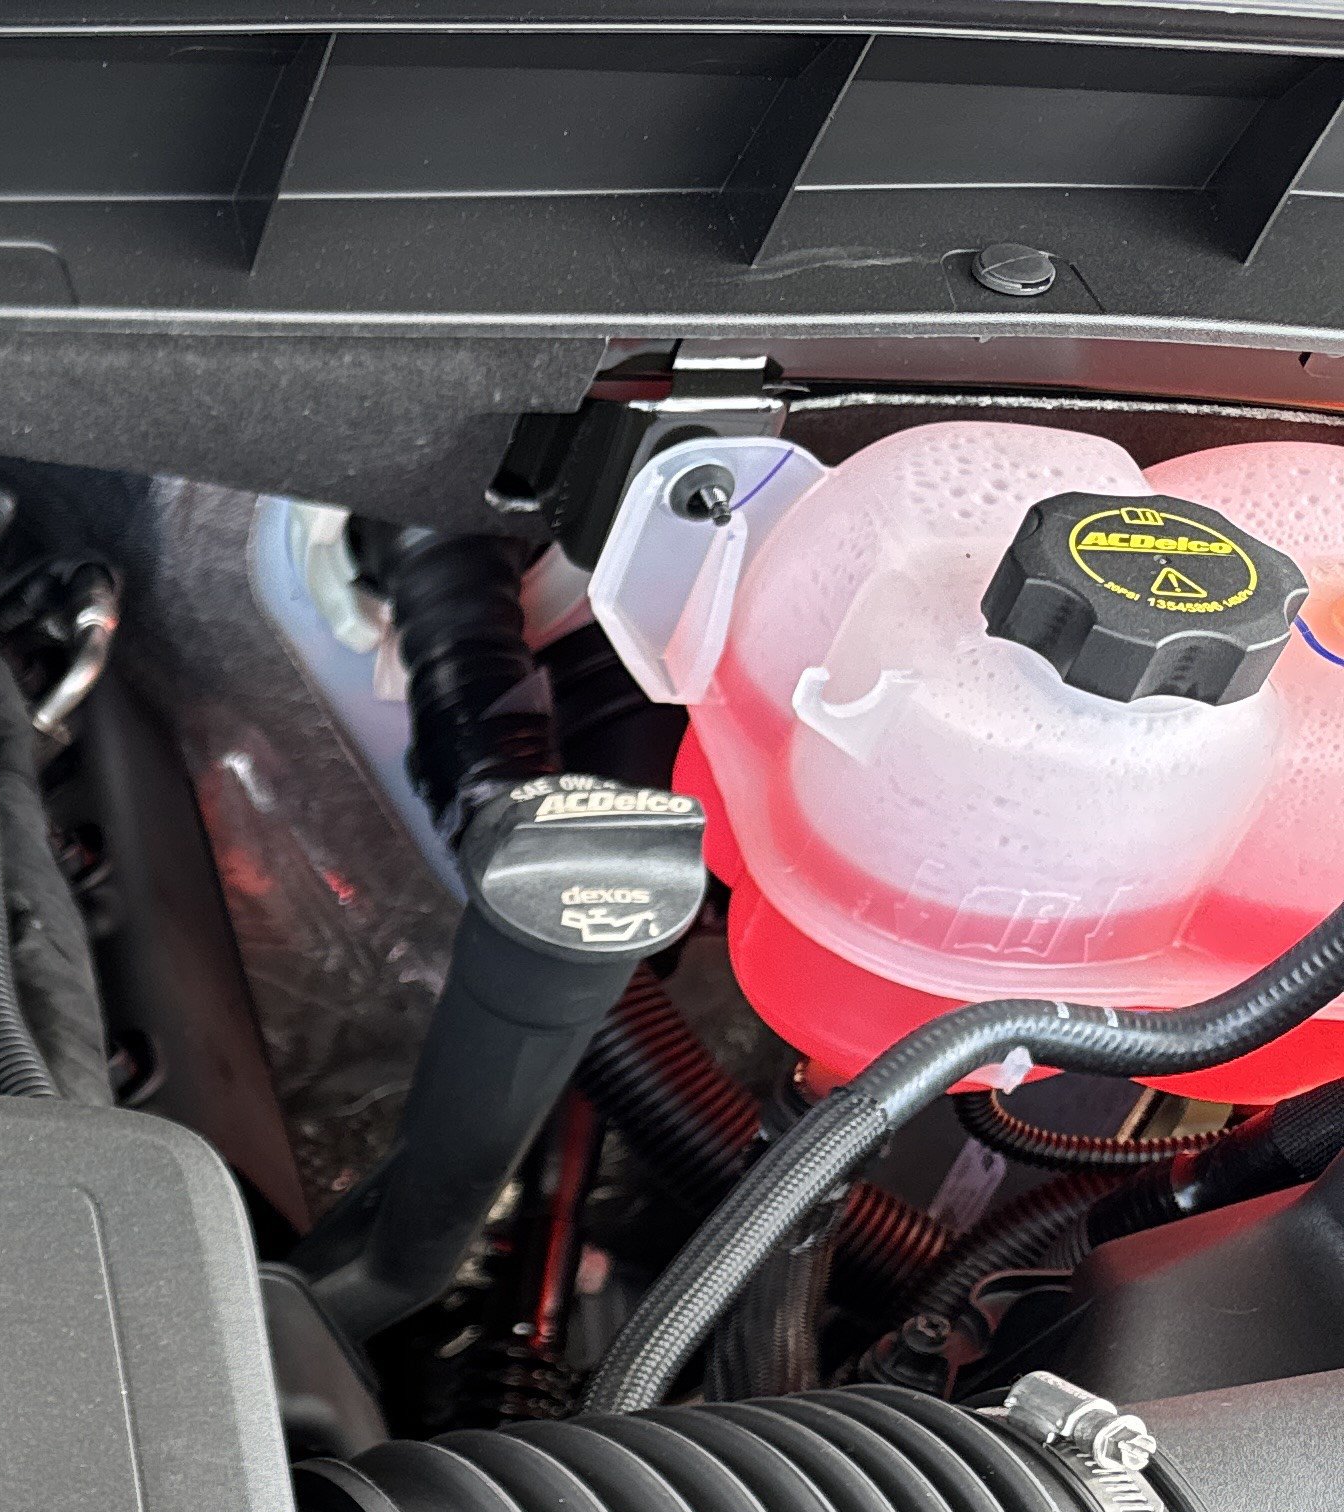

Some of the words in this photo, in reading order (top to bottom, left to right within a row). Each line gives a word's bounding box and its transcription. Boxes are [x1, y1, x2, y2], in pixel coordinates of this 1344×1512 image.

[1079, 531, 1233, 554] ACDelco
[510, 777, 554, 802] SAE
[535, 789, 694, 815] ACDelco
[560, 886, 650, 905] dexos
